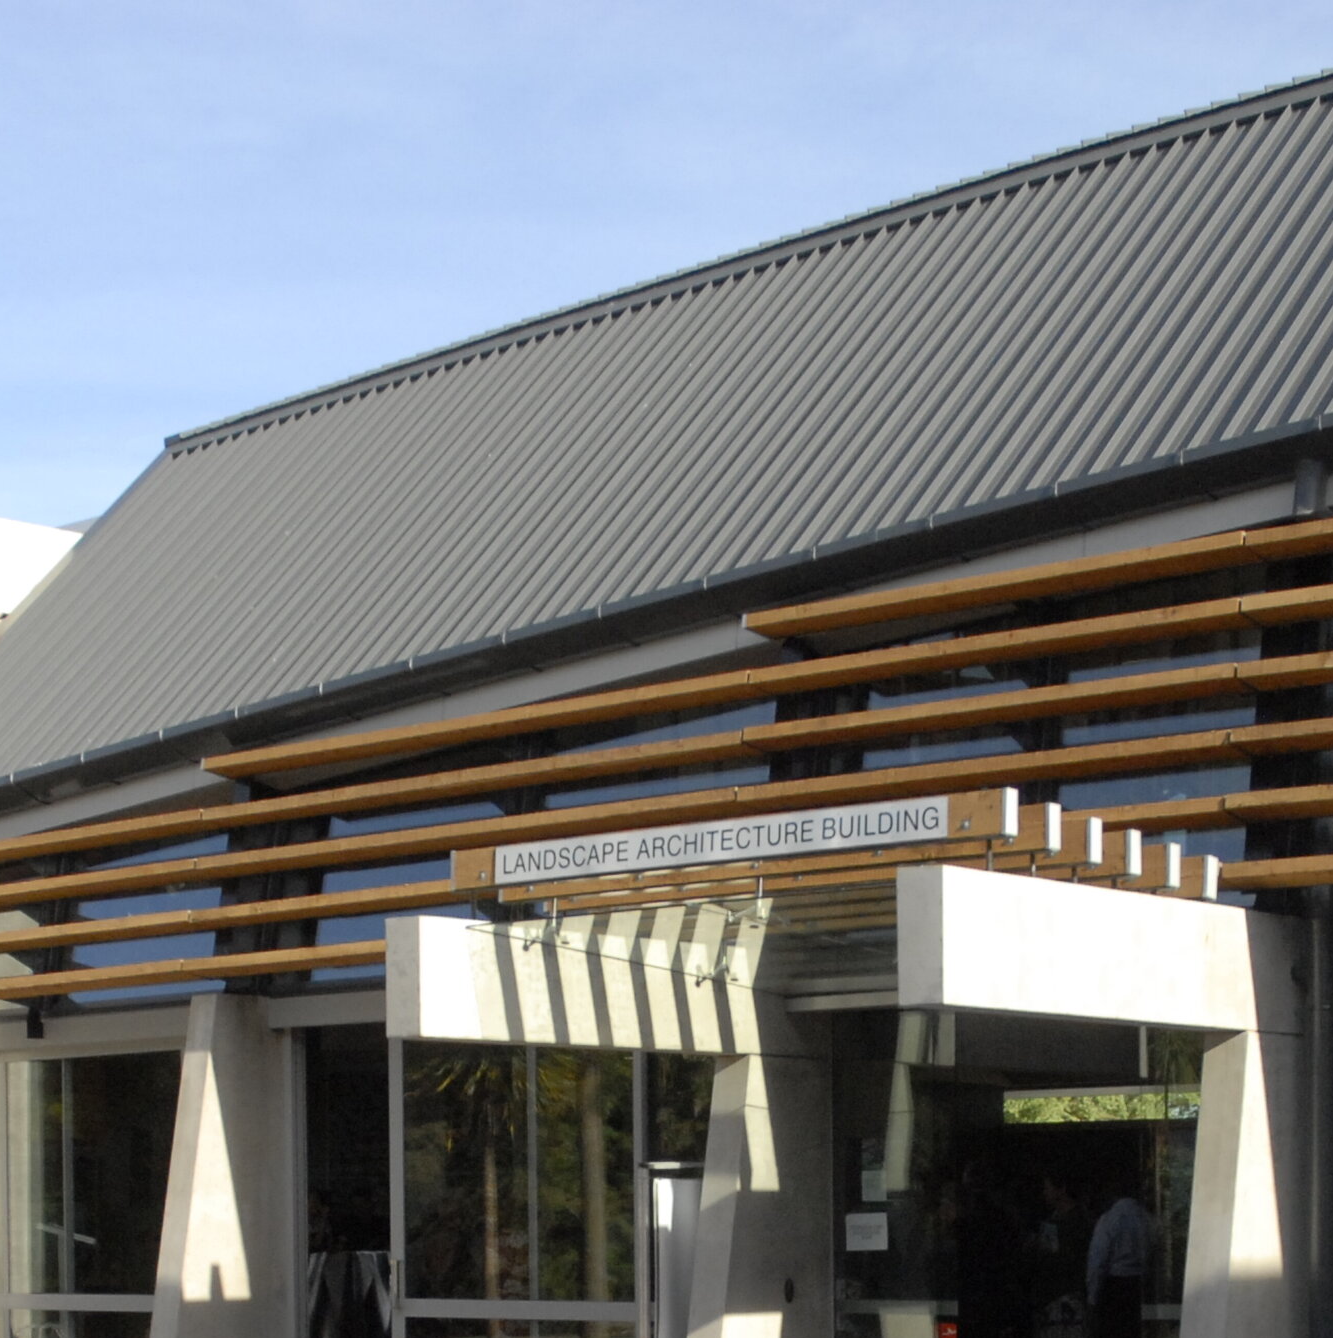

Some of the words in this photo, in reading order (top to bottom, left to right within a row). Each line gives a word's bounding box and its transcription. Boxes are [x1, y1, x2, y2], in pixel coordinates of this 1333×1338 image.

[501, 839, 629, 876] LANDSCAPE
[635, 819, 815, 863] ARCHITECTURE
[820, 805, 941, 840] BUILDING
